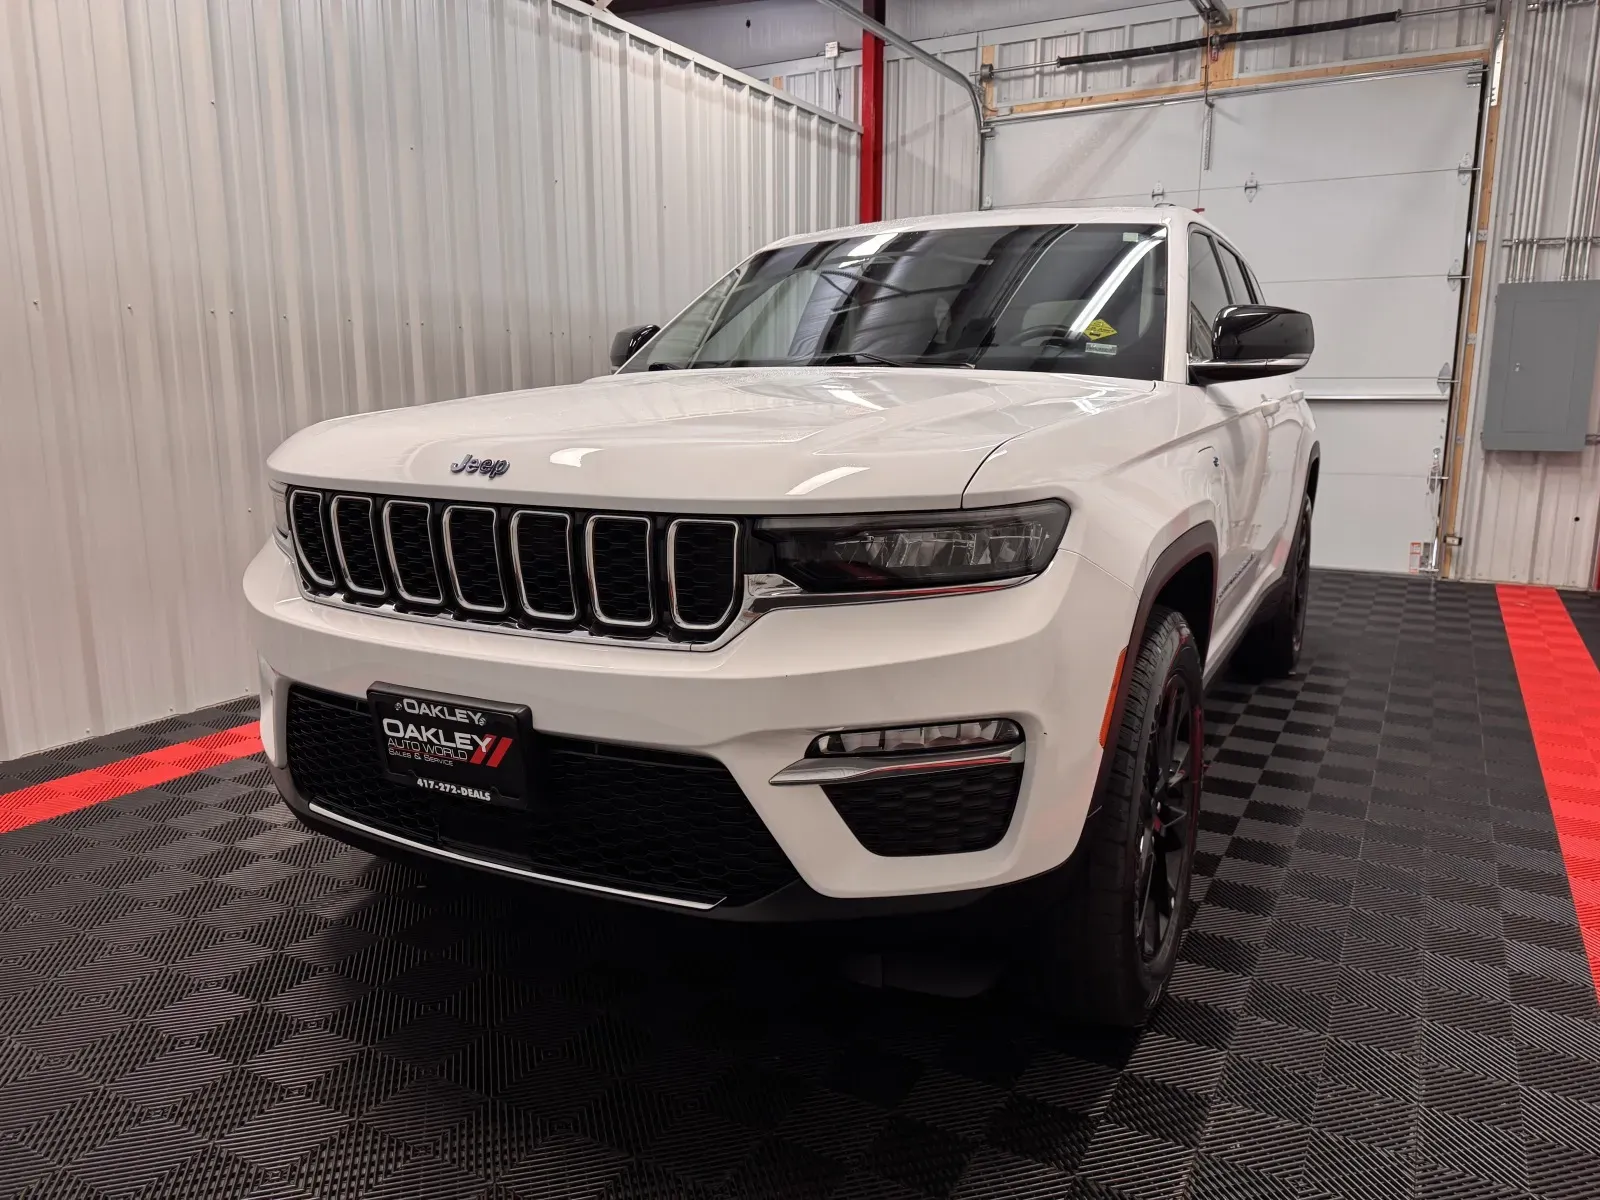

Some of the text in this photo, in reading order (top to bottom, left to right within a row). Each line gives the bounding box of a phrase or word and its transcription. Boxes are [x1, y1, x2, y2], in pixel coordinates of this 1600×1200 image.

[450, 453, 510, 479] Jeep
[403, 698, 482, 725] OAKLEY
[382, 717, 493, 753] OAKLEY
[388, 737, 468, 760] AUTO WORLD
[414, 752, 422, 760] &
[416, 778, 491, 801] 417-272-DEALS
